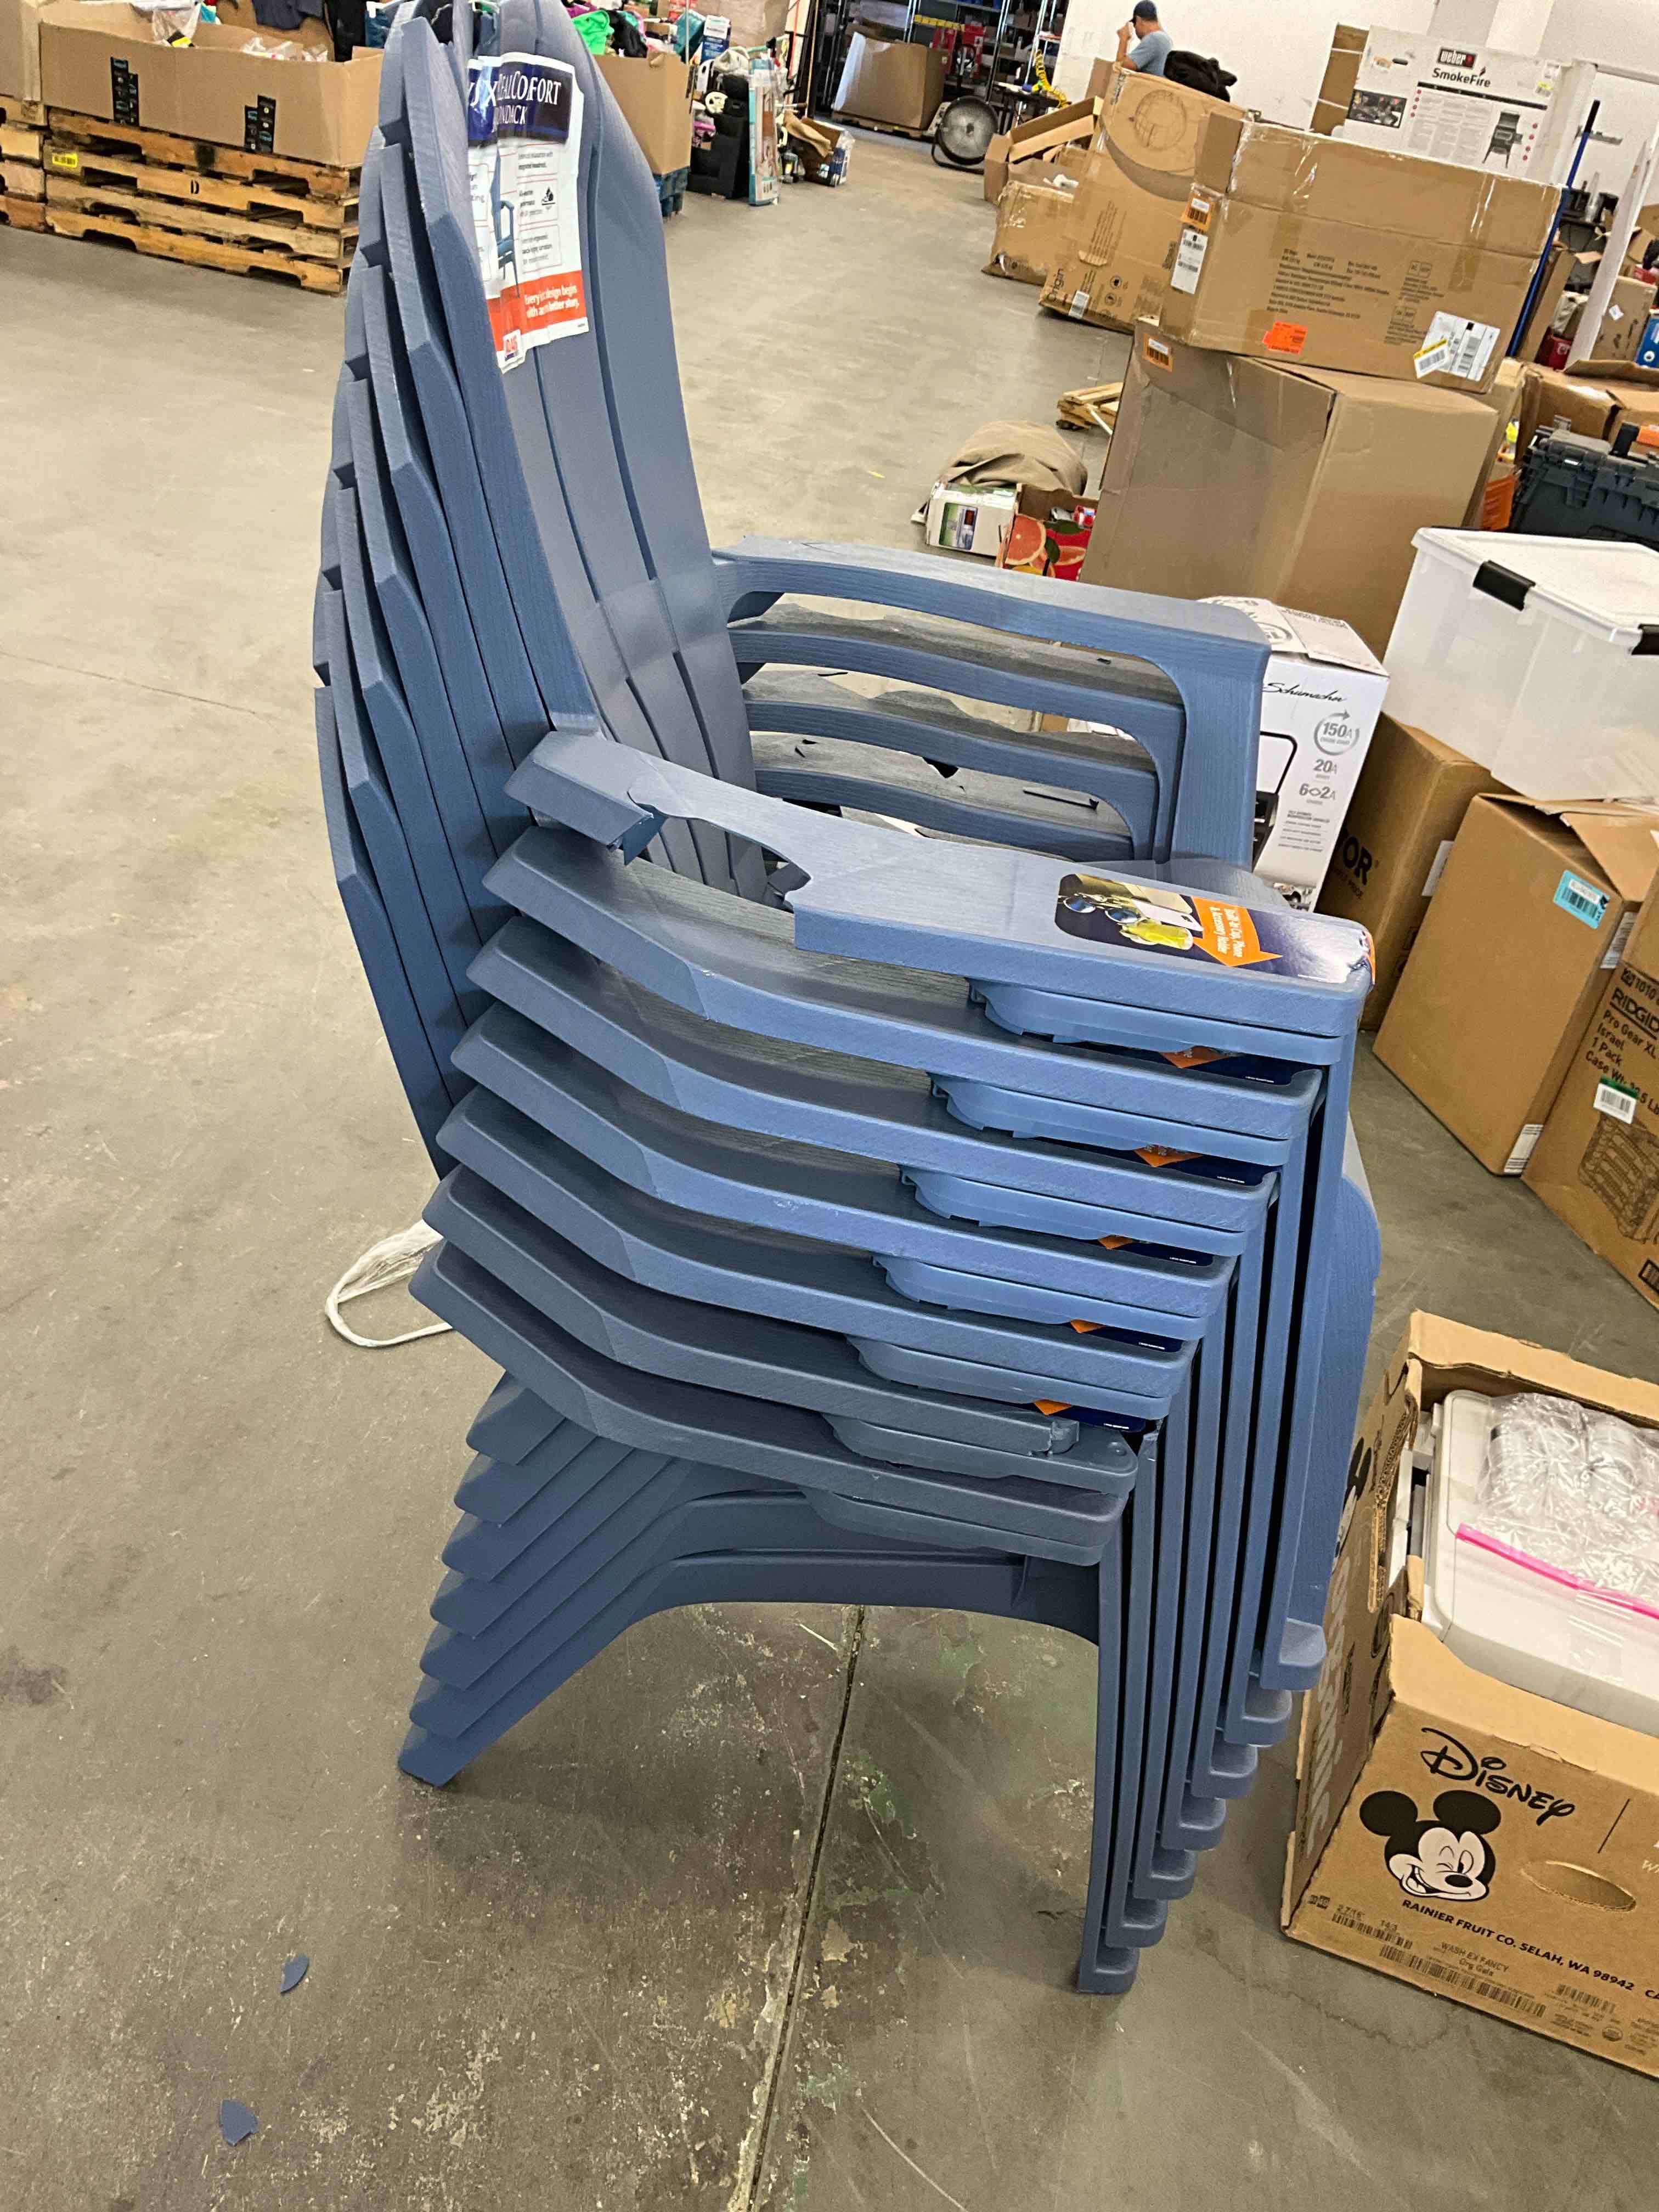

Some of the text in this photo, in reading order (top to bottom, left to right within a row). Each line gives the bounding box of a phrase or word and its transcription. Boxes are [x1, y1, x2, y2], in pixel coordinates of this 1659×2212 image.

[1440, 50, 1466, 65] weber
[1432, 67, 1491, 88] SmokeFire
[1262, 682, 1346, 702] Schumacher
[1323, 722, 1352, 738] 150A
[1313, 759, 1338, 775] 20A
[1612, 987, 1659, 1033] RIDGID
[1598, 1023, 1624, 1051] Israel
[1603, 1009, 1656, 1059] Pro Gear XL
[1585, 1051, 1609, 1073] Case
[1592, 1037, 1622, 1066] 1 Pack
[1420, 1728, 1575, 1826] Disney
[1402, 1900, 1454, 1923] RAINIER
[1455, 1919, 1495, 1937] FRUIT
[1496, 1934, 1516, 1948] CO.
[1519, 1943, 1564, 1966] SELAH,
[1568, 1960, 1590, 1974] WA
[1593, 1970, 1635, 1990] 98942
[1480, 1957, 1509, 1973] FANCY
